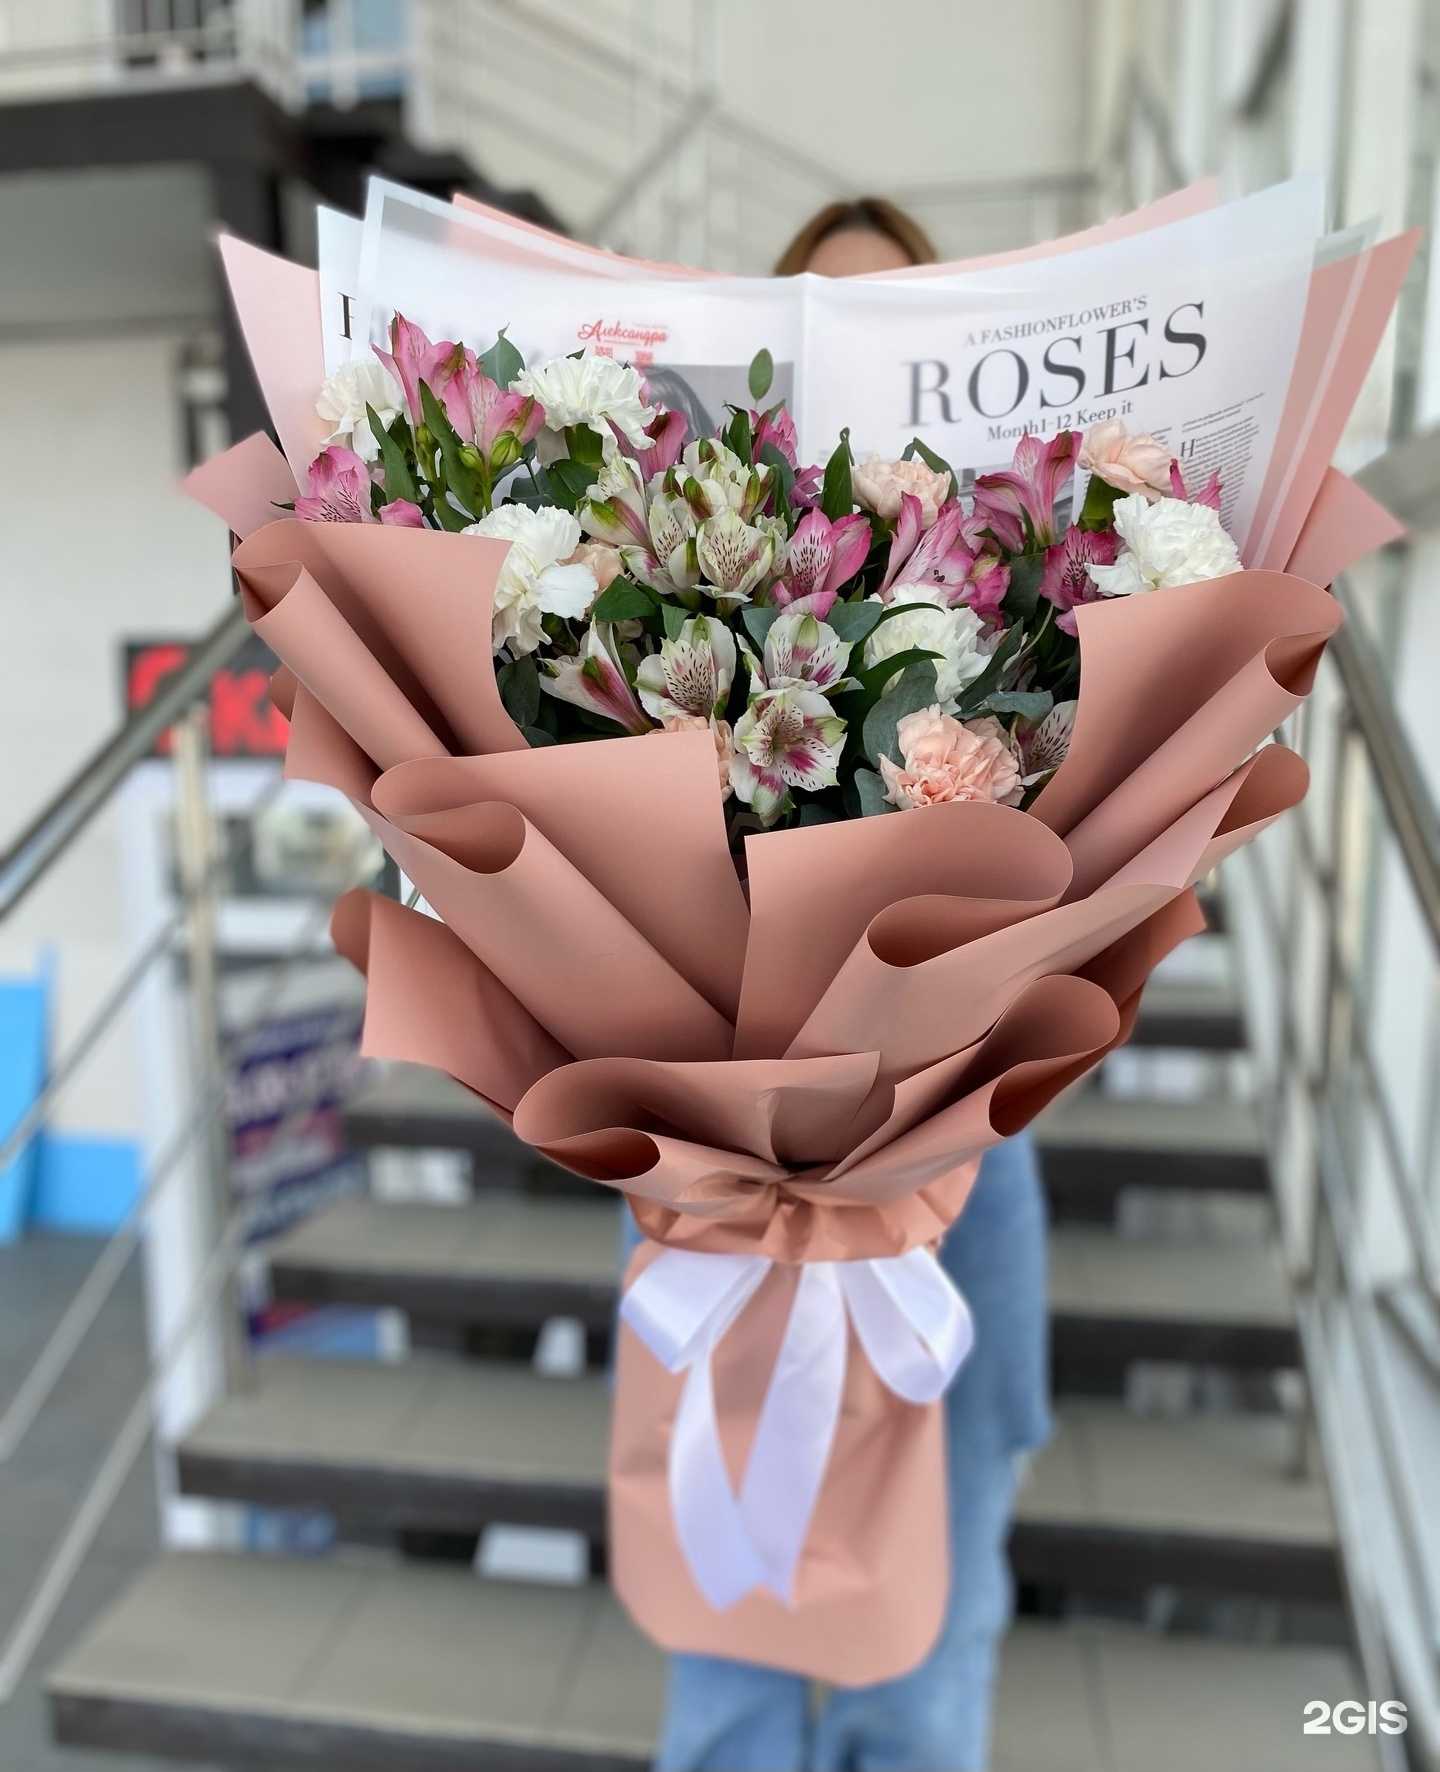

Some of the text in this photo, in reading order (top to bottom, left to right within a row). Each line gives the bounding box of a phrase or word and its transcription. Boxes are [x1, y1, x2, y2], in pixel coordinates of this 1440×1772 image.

[964, 295, 1148, 347] A FASHIONFLOWER'S
[899, 301, 1208, 427] ROSES
[1076, 406, 1117, 425] Keep
[1120, 399, 1134, 416] it
